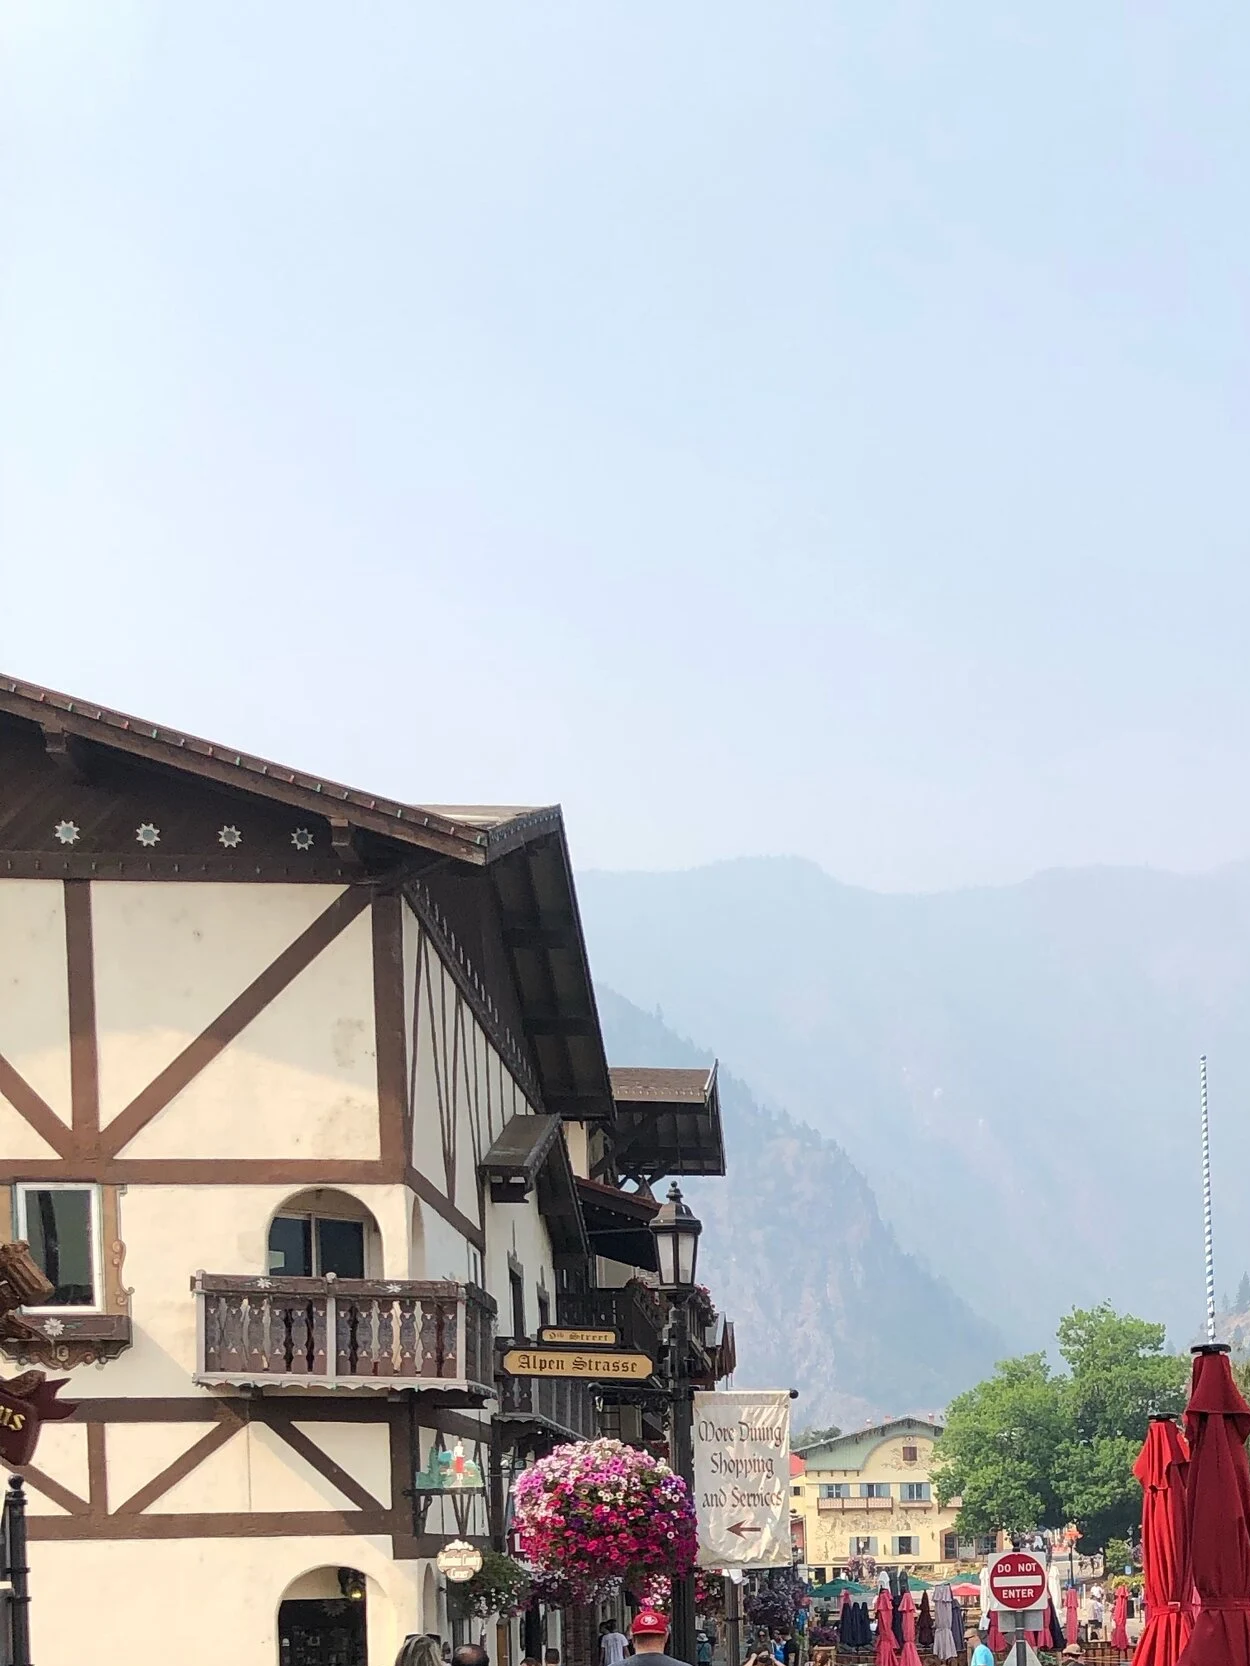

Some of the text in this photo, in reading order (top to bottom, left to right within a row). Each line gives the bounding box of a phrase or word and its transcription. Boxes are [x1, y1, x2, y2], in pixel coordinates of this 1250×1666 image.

[569, 1332, 609, 1341] Street
[518, 1354, 637, 1373] Alpen Strasse
[699, 1421, 735, 1441] More
[710, 1452, 774, 1479] Shopping
[702, 1486, 782, 1508] and Services
[997, 1562, 1037, 1573] DO NOT
[1002, 1588, 1035, 1599] ENTER
